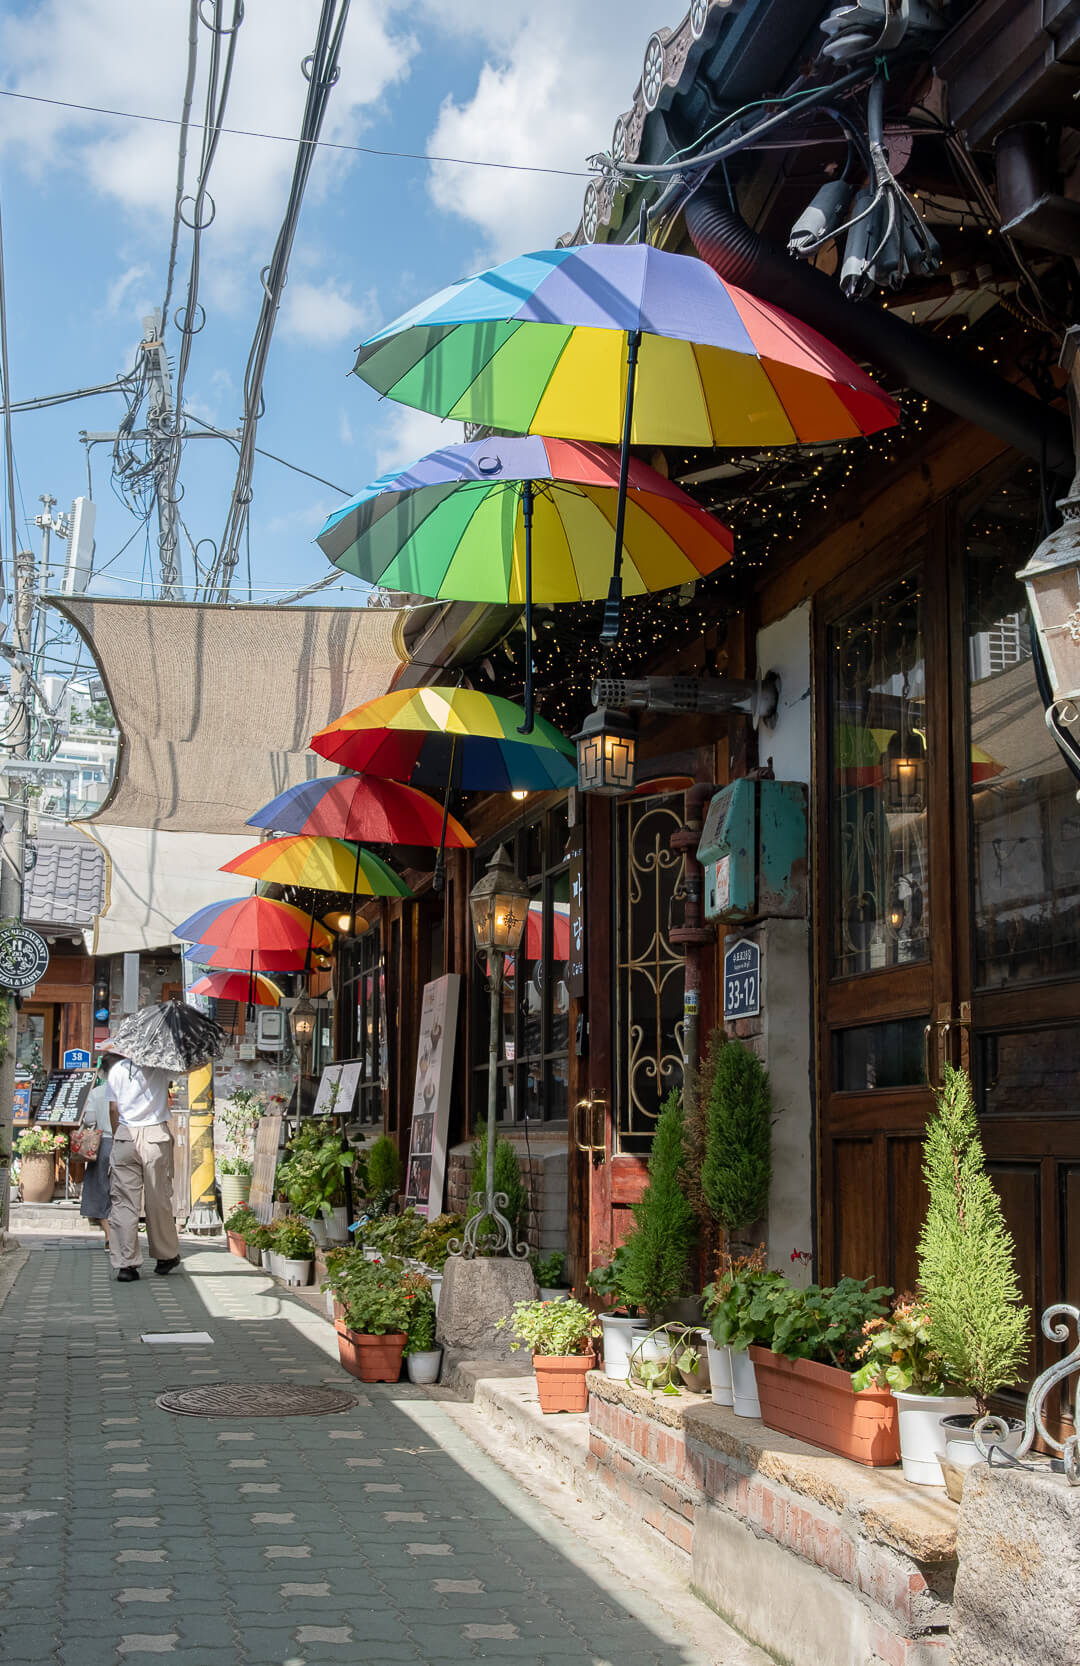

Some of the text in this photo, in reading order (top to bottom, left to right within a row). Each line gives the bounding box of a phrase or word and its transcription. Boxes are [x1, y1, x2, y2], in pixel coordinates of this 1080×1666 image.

[21, 970, 42, 985] PASTA
[728, 976, 756, 1010] 33-12
[71, 1052, 83, 1061] 38
